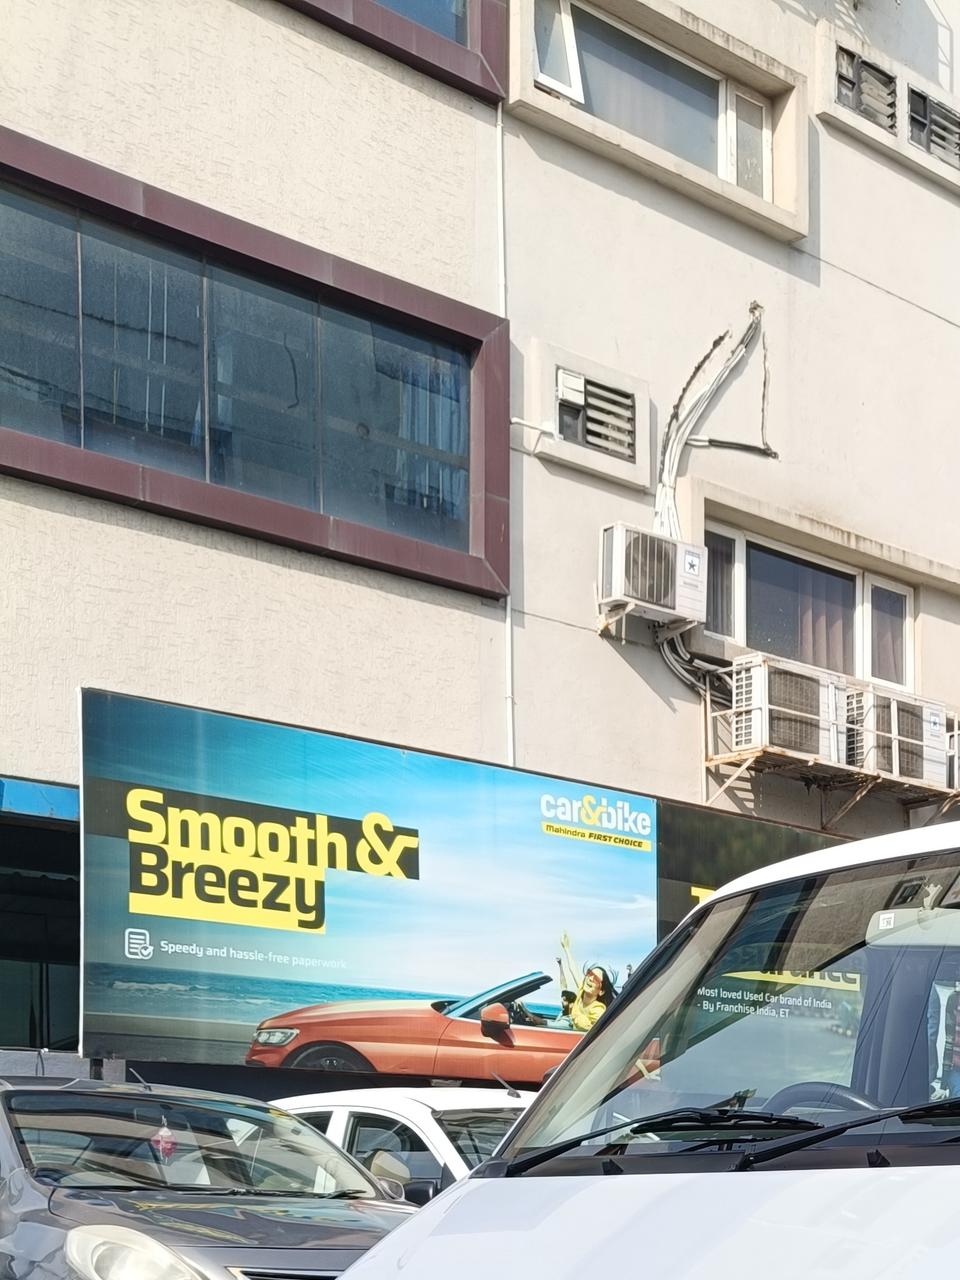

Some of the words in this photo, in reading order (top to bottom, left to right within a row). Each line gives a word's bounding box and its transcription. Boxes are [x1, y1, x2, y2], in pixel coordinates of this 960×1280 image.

[540, 794, 652, 836] car&bike
[126, 788, 348, 871] Smooth
[356, 812, 419, 879] &
[588, 832, 612, 843] FIRST
[613, 836, 643, 848] CHOICE
[129, 842, 326, 930] Breezy
[160, 940, 204, 957] Speedy
[206, 947, 227, 958] and
[229, 947, 290, 965] hassle-free
[291, 955, 348, 970] paperwork
[697, 986, 719, 998] Most
[720, 988, 742, 1001] loved
[743, 990, 764, 1002] Used
[764, 992, 780, 1004] Car
[780, 993, 802, 1007] brand
[803, 997, 813, 1008] of
[813, 997, 832, 1010] India
[702, 1001, 715, 1013] By
[716, 1002, 756, 1015] Franchise
[756, 1006, 779, 1019] India,
[780, 1008, 790, 1018] ET
